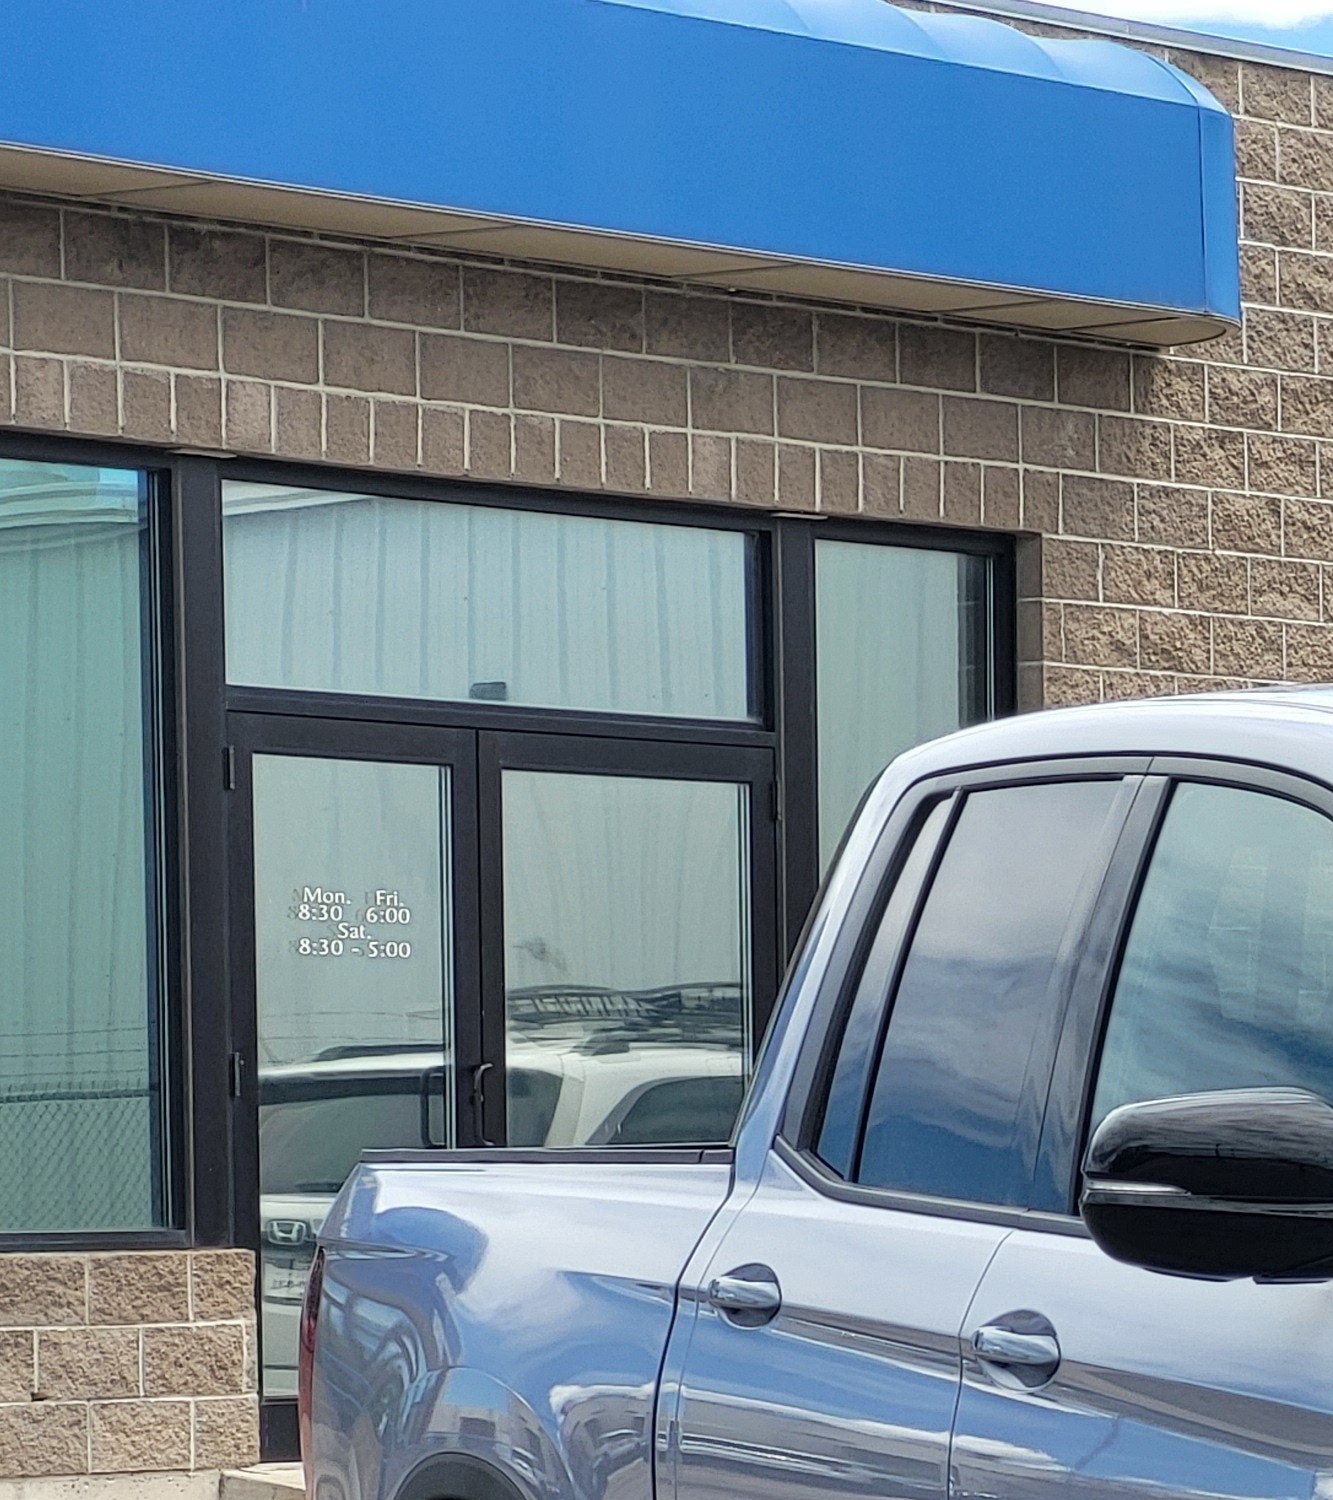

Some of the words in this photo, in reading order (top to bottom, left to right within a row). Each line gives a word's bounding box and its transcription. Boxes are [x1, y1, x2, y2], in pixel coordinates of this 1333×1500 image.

[303, 887, 351, 904] Mon.
[375, 890, 404, 907] Fri.
[298, 904, 343, 921] 8:30
[366, 908, 411, 924] 6:00
[337, 923, 372, 939] Sat.
[299, 938, 343, 955] 8:30
[368, 942, 411, 958] 5:00
